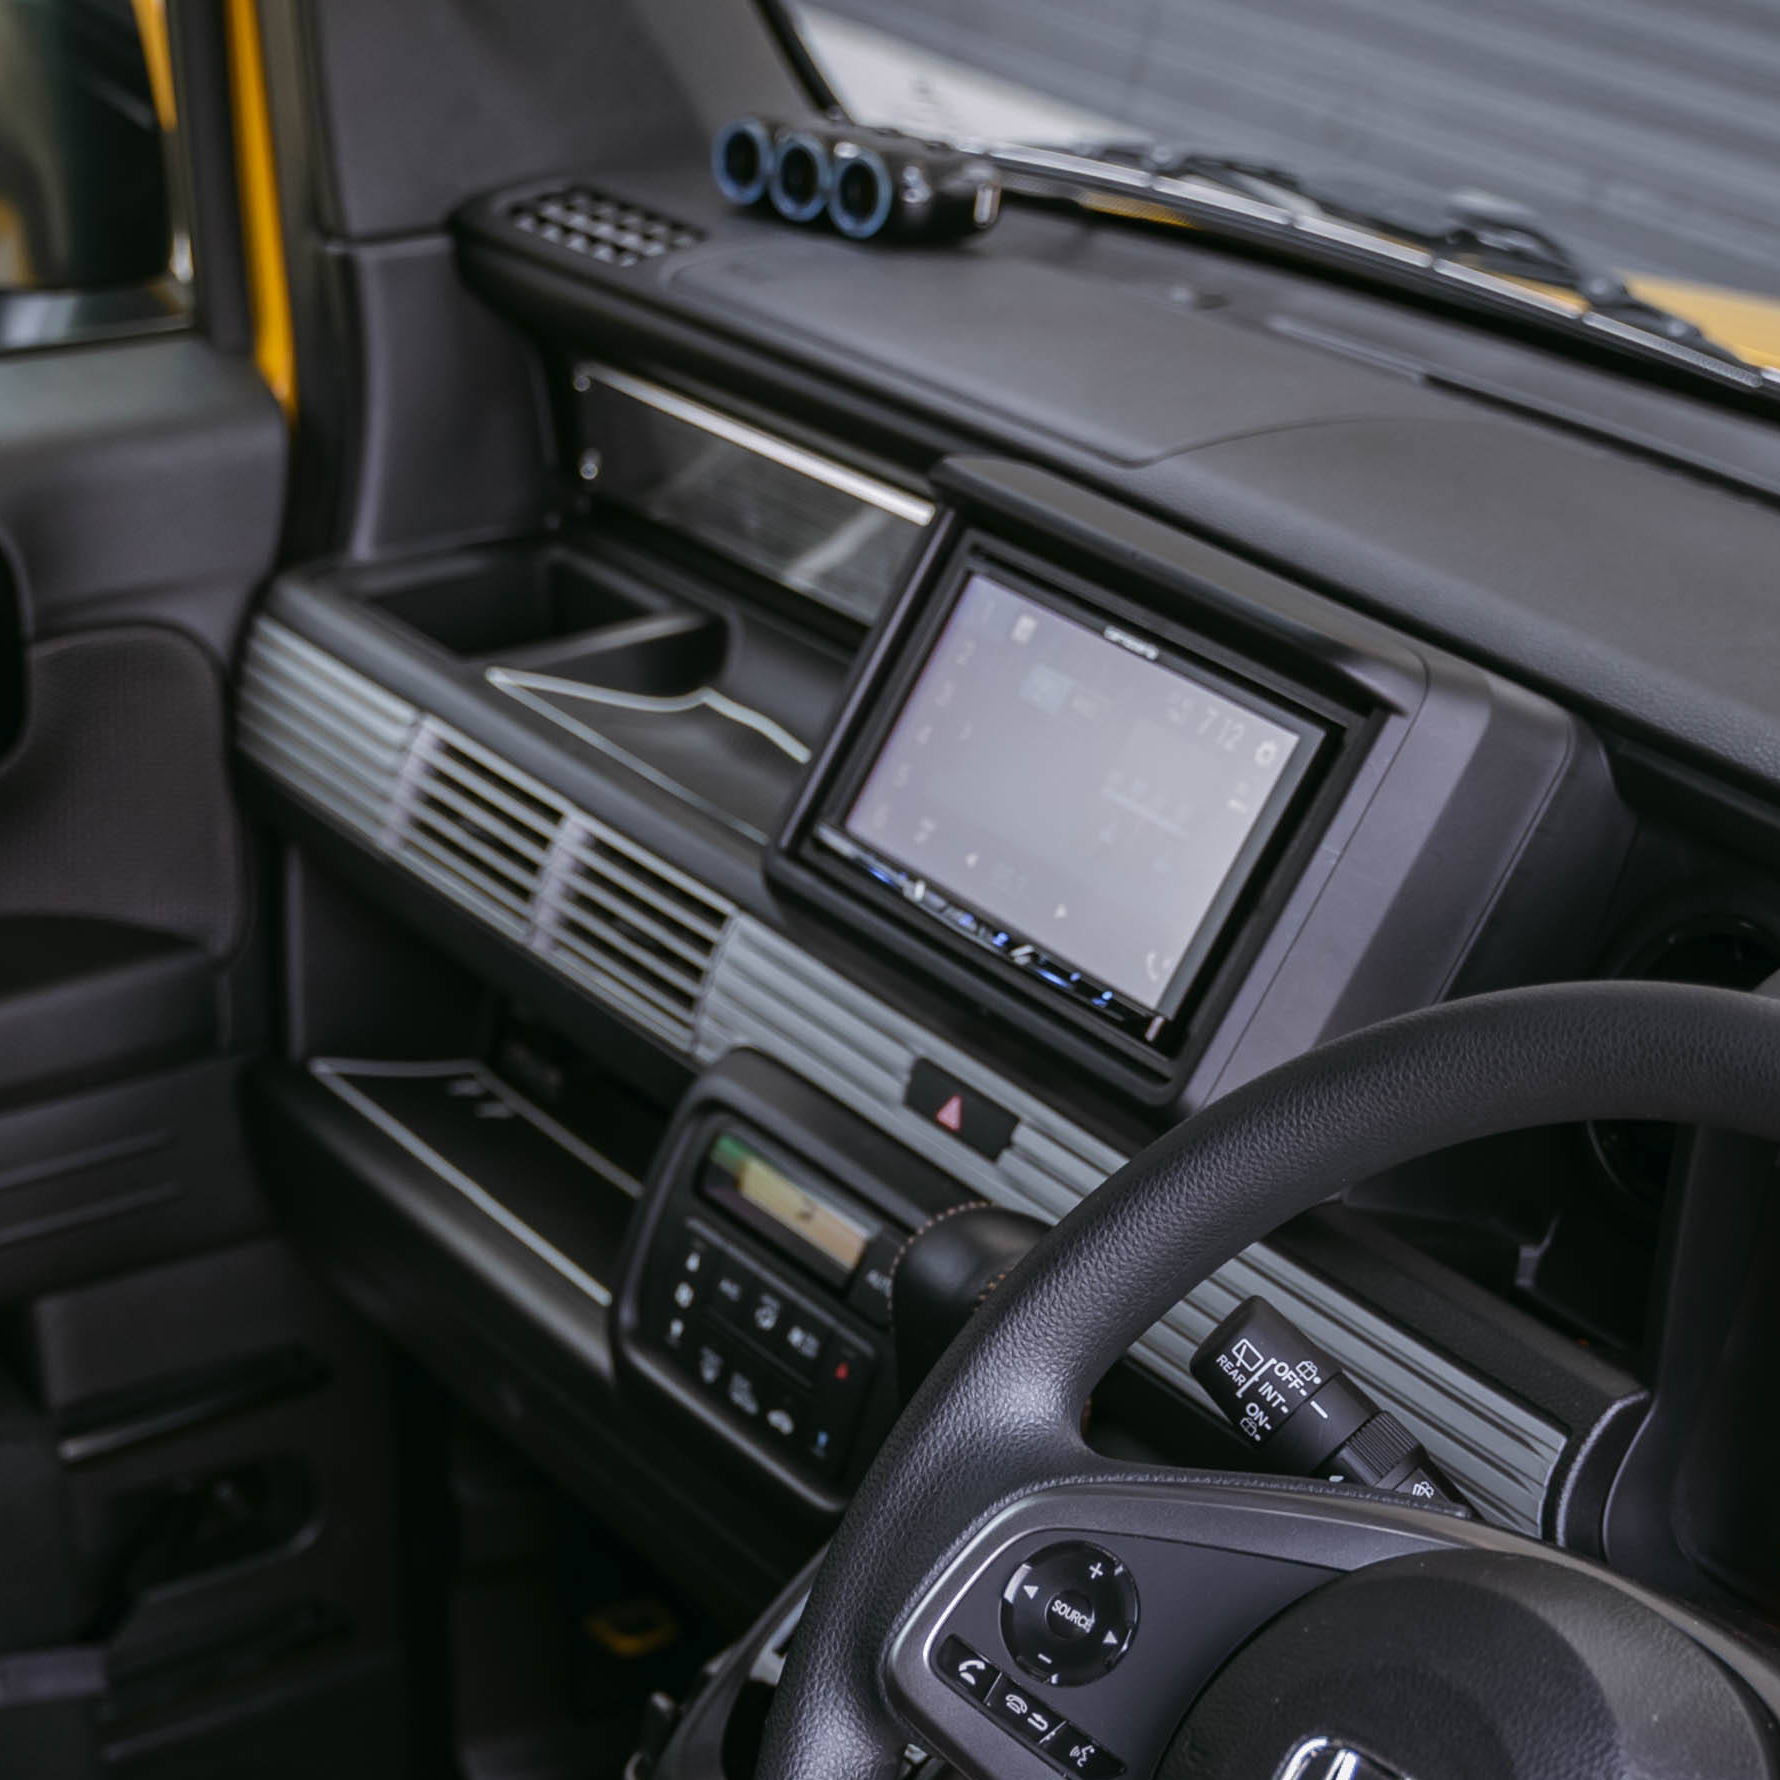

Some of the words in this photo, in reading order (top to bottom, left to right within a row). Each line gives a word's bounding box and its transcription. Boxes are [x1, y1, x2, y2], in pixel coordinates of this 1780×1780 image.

[1216, 1354, 1247, 1386] REAR
[1274, 1362, 1305, 1389] OFF
[1258, 1382, 1286, 1408] INT
[1246, 1402, 1269, 1427] ON
[1052, 1599, 1095, 1633] SOURCE
